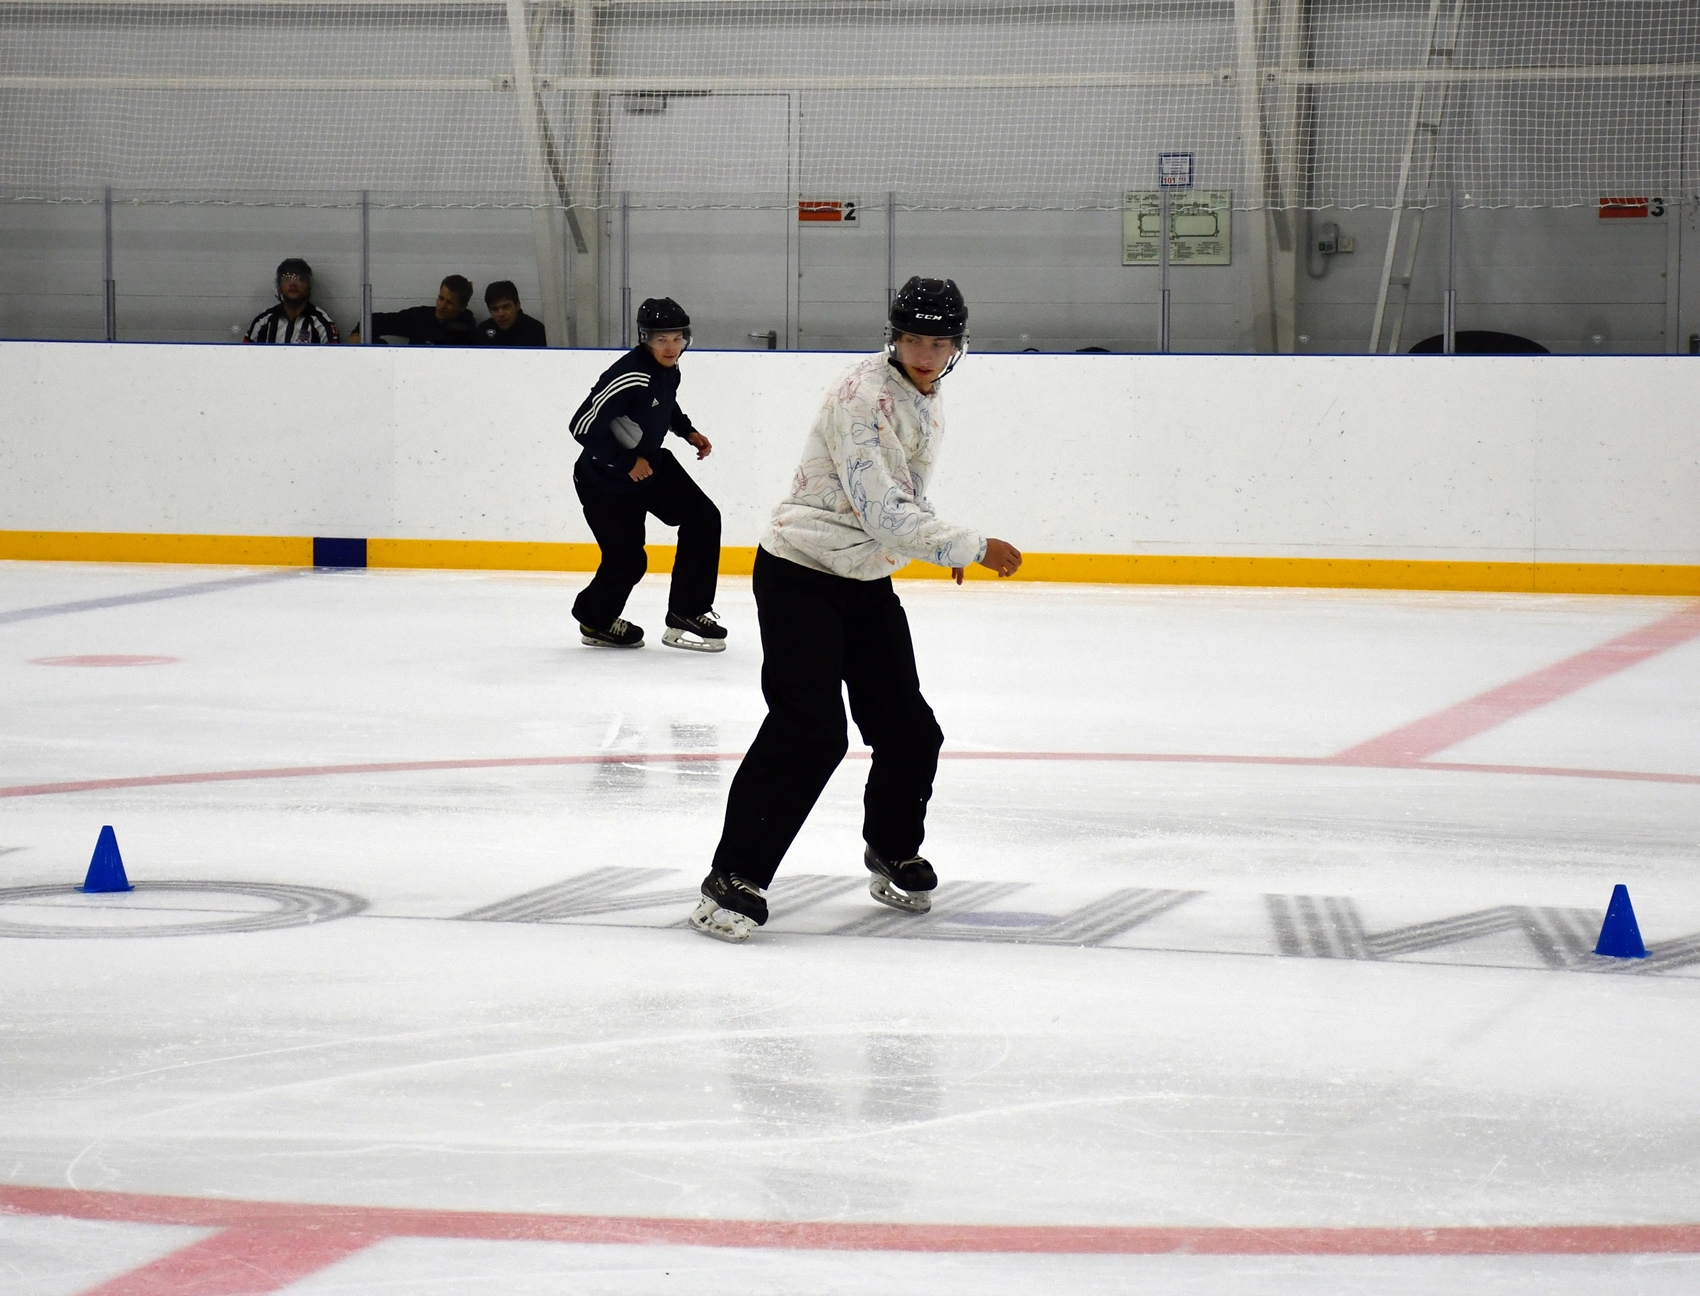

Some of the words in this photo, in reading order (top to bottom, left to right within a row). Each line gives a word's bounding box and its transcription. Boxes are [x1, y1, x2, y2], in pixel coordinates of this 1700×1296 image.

[844, 202, 856, 221] 2
[1650, 198, 1665, 217] 3
[915, 313, 943, 321] CCM
